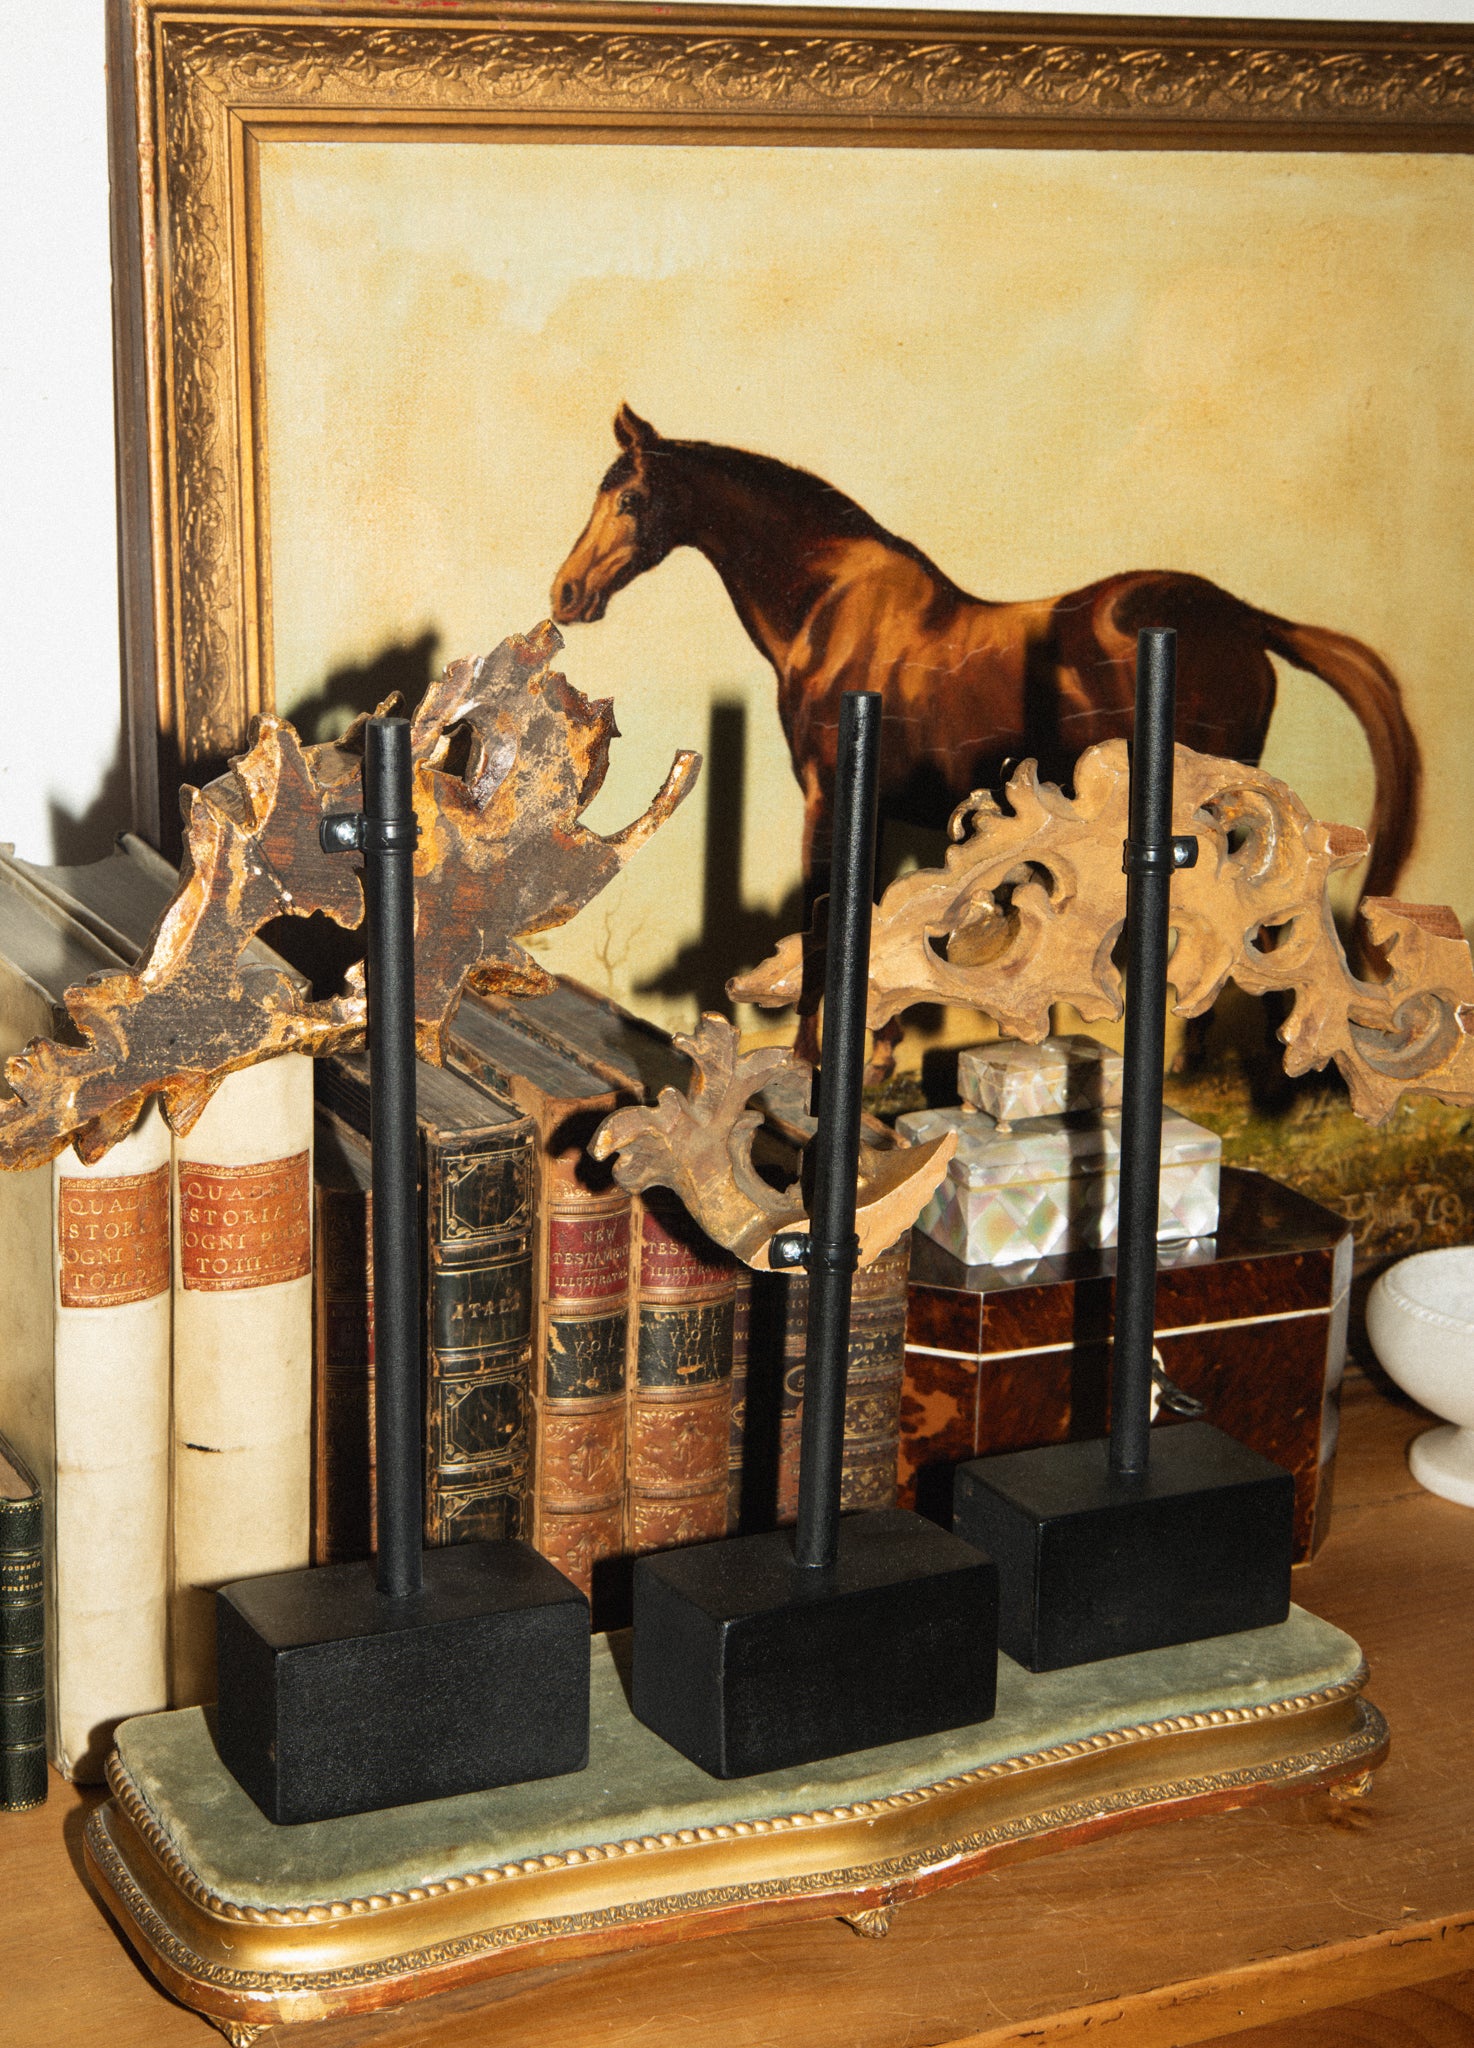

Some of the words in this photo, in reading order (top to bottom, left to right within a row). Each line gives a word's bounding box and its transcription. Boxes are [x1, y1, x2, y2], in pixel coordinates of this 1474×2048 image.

[189, 1206, 285, 1226] STORIA
[185, 1231, 246, 1251] OGNI
[583, 1228, 616, 1244] NEW
[63, 1247, 123, 1264] OGNI
